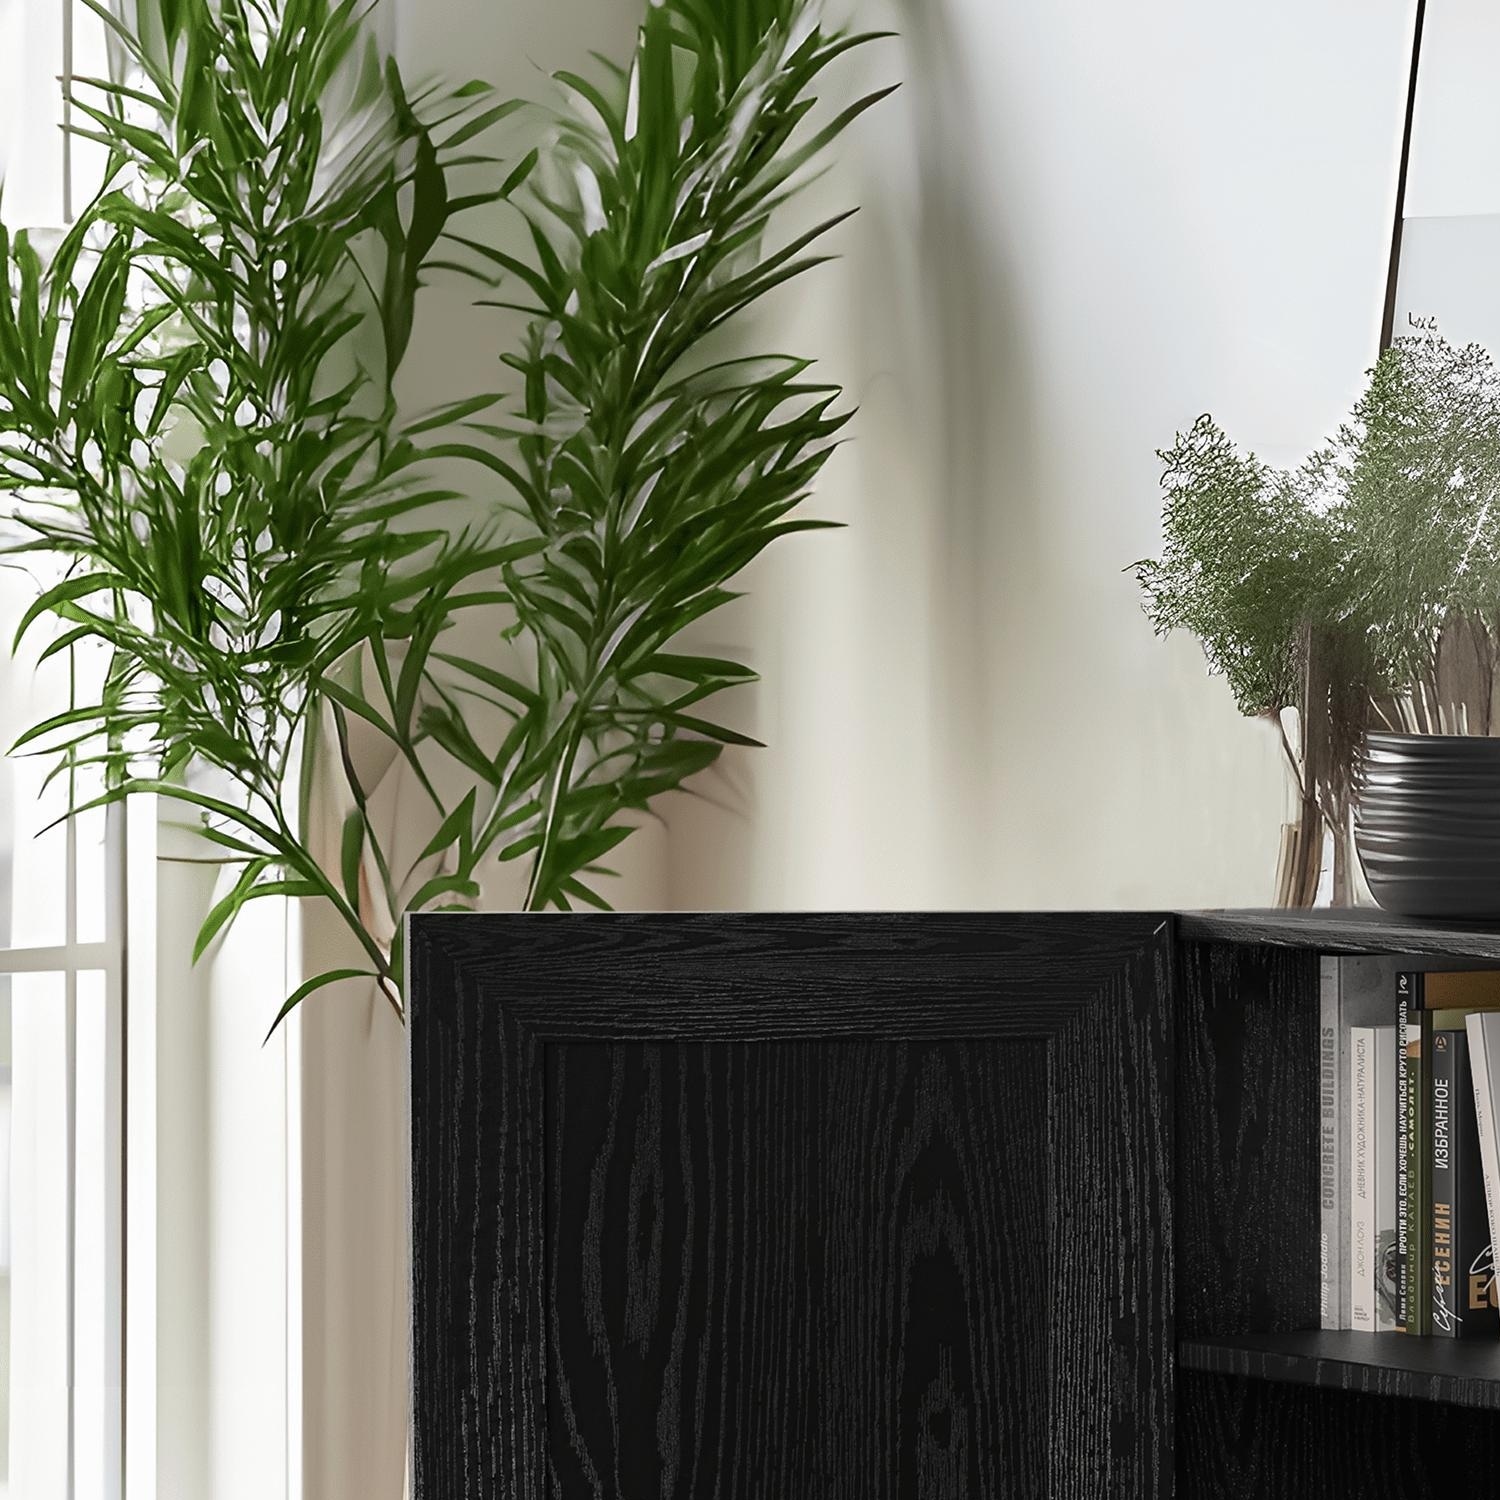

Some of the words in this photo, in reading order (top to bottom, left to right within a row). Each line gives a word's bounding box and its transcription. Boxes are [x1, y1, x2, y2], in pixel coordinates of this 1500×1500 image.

[1399, 1000, 1407, 1046] РИСОВАТЬ
[1322, 1027, 1335, 1119] BUILDINGS
[1399, 1047, 1407, 1078] КРУТО
[1399, 1081, 1407, 1133] НАУЧИТЬСЯ
[1434, 1078, 1449, 1169] ИЗБРАННОЕ
[1322, 1126, 1335, 1210] CONCRETE
[1399, 1134, 1407, 1172] ХОЧЕШЬ
[1356, 1159, 1366, 1199] ДНЕВНИК
[1399, 1173, 1407, 1196] ЕСЛИ
[1399, 1219, 1407, 1255] ПРОЧТИ
[1435, 1202, 1451, 1286] ЕСЕНИН
